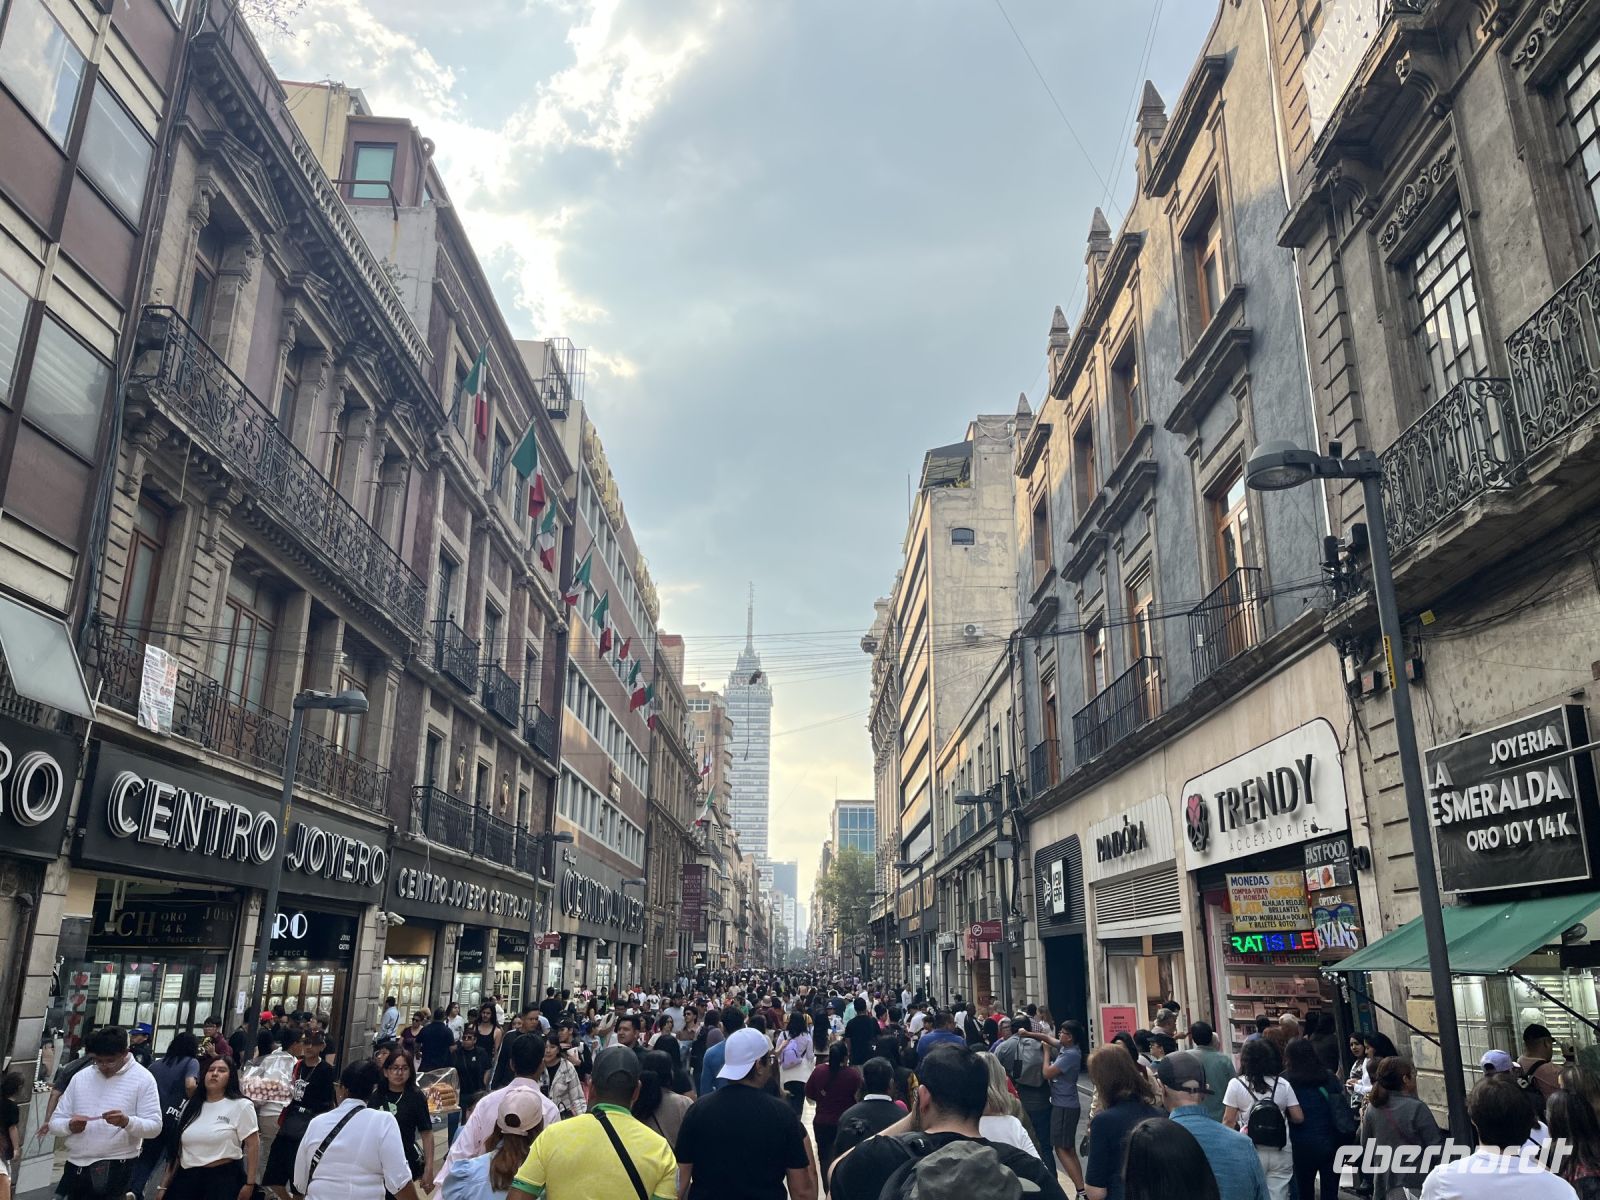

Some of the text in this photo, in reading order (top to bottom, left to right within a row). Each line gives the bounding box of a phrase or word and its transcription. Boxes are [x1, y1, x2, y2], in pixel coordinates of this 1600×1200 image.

[1489, 725, 1561, 765] JOYERIA
[1214, 753, 1316, 833] TRENDY
[1426, 762, 1453, 790] LA
[1428, 766, 1571, 827] ESMERALDA
[107, 770, 386, 887] CENTRO JOYERO
[1096, 814, 1148, 863] PANDORA
[1228, 816, 1318, 853] ACCESSORIES
[1467, 826, 1501, 852] ORO
[1504, 820, 1521, 846] 10
[1525, 819, 1534, 842] Y
[1305, 840, 1347, 864] FAST FOOD
[398, 867, 448, 905] CENTRO
[448, 879, 488, 912] JOYERO
[489, 889, 519, 918] CENTRO
[562, 868, 613, 925] CENTRO
[1231, 875, 1270, 887] MONEDAS
[1243, 894, 1268, 902] MONEDAS
[1262, 899, 1285, 907] ALHAJAS
[1269, 905, 1300, 913] BRILLANTES
[1249, 920, 1297, 929] Y BILLETES ROTOS
